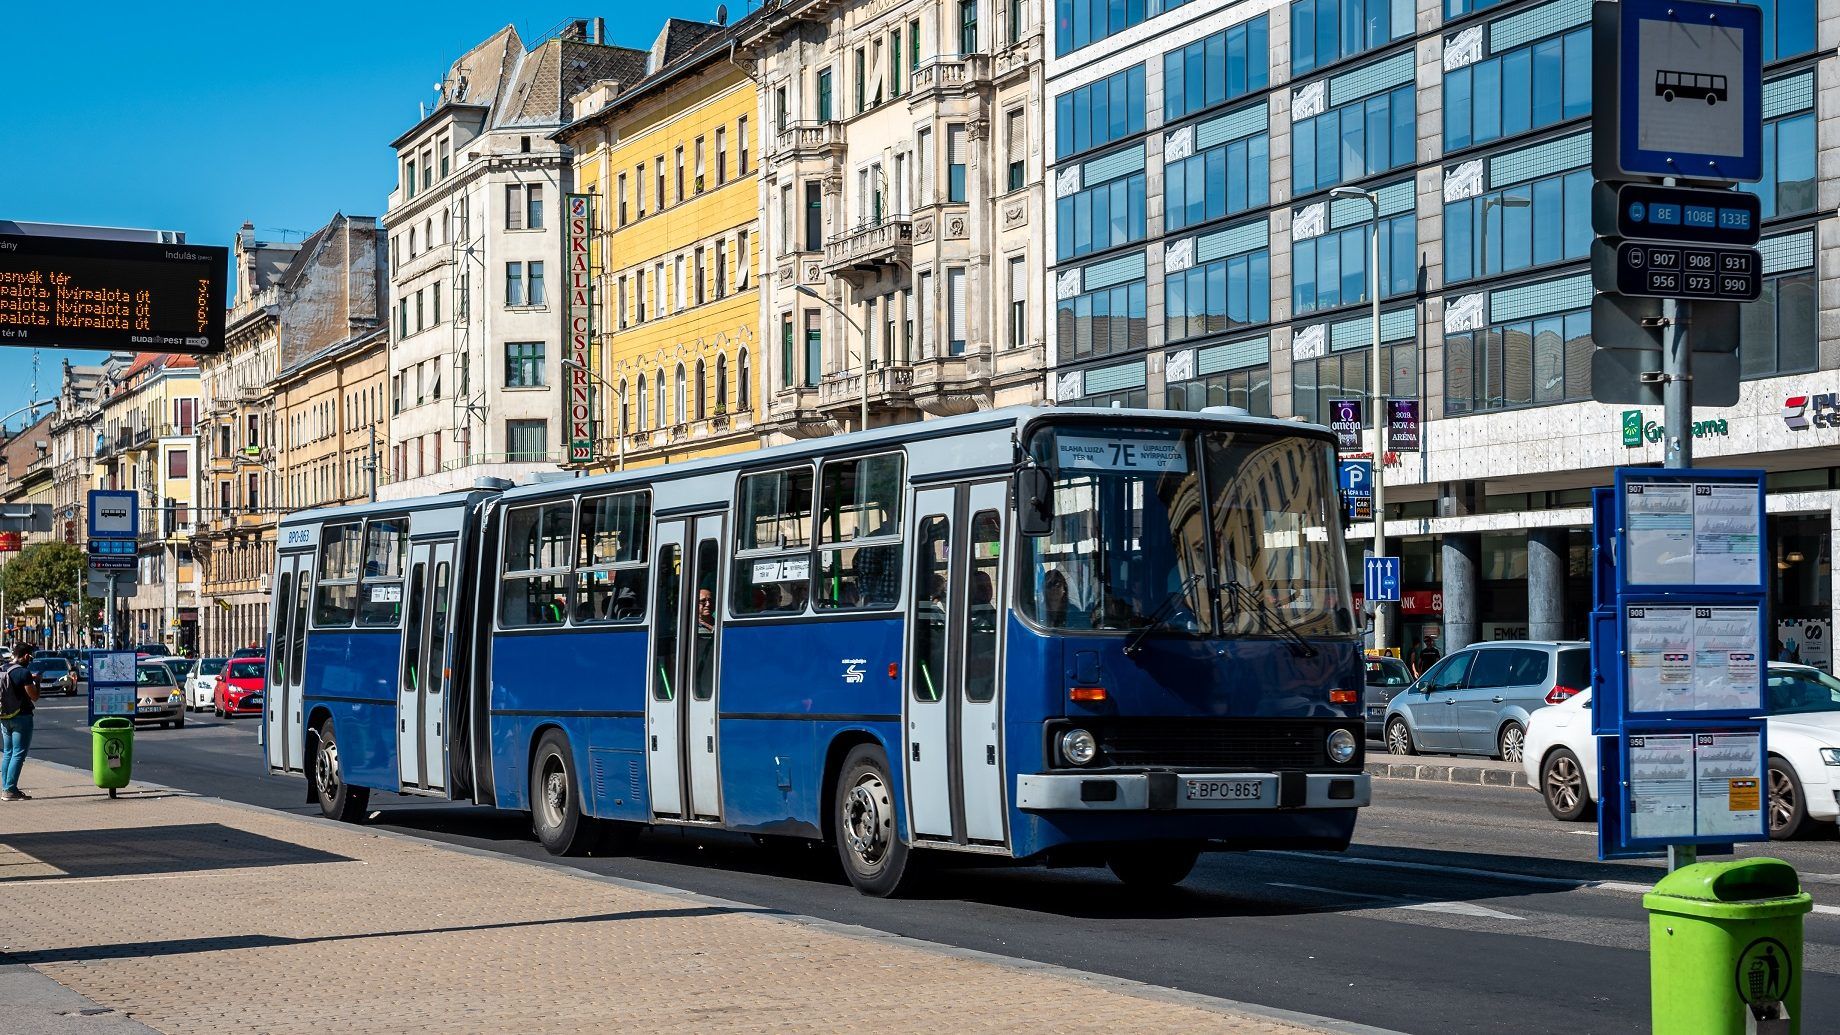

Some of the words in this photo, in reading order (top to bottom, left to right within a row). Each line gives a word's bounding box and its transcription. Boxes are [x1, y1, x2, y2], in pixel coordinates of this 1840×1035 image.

[1658, 208, 1672, 220] 8E
[1686, 210, 1713, 223] 108E
[1721, 213, 1748, 225] 133E
[0, 241, 18, 251] ány
[165, 250, 197, 260] Indulás
[572, 219, 587, 306] SKÁLA
[1653, 253, 1675, 266] 907
[1689, 255, 1711, 268] 908
[1725, 257, 1746, 270] 931
[50, 271, 71, 285] tér
[1653, 275, 1675, 288] 956
[1689, 277, 1711, 290] 973
[1724, 279, 1746, 291] 990
[57, 286, 130, 302] Nyírpalota
[136, 289, 150, 303] út
[56, 300, 130, 316] Nyírpalota
[136, 303, 150, 317] út
[56, 314, 129, 330] Nyírpalota
[135, 317, 150, 331] út
[2, 329, 15, 338] tér
[17, 330, 28, 338] M
[572, 316, 589, 438] CSARNOK
[1331, 421, 1361, 434] omega
[1392, 421, 1408, 429] NOV.
[1391, 432, 1417, 441] ARÉNA
[1060, 445, 1083, 453] BLAHA
[1084, 446, 1105, 454] LUJZA
[1108, 443, 1137, 467] 7E
[1140, 451, 1183, 460] NYÍRPALOTA
[1073, 453, 1086, 461] TÉR
[1350, 470, 1363, 488] P
[1628, 485, 1642, 493] 907
[288, 529, 310, 544] BPO-863
[1630, 609, 1643, 617] 908
[1696, 609, 1710, 617] 931
[1494, 627, 1526, 640] EMKE
[1629, 738, 1643, 746] 956
[1699, 736, 1712, 744] 990
[1200, 783, 1259, 797] BPO-863
